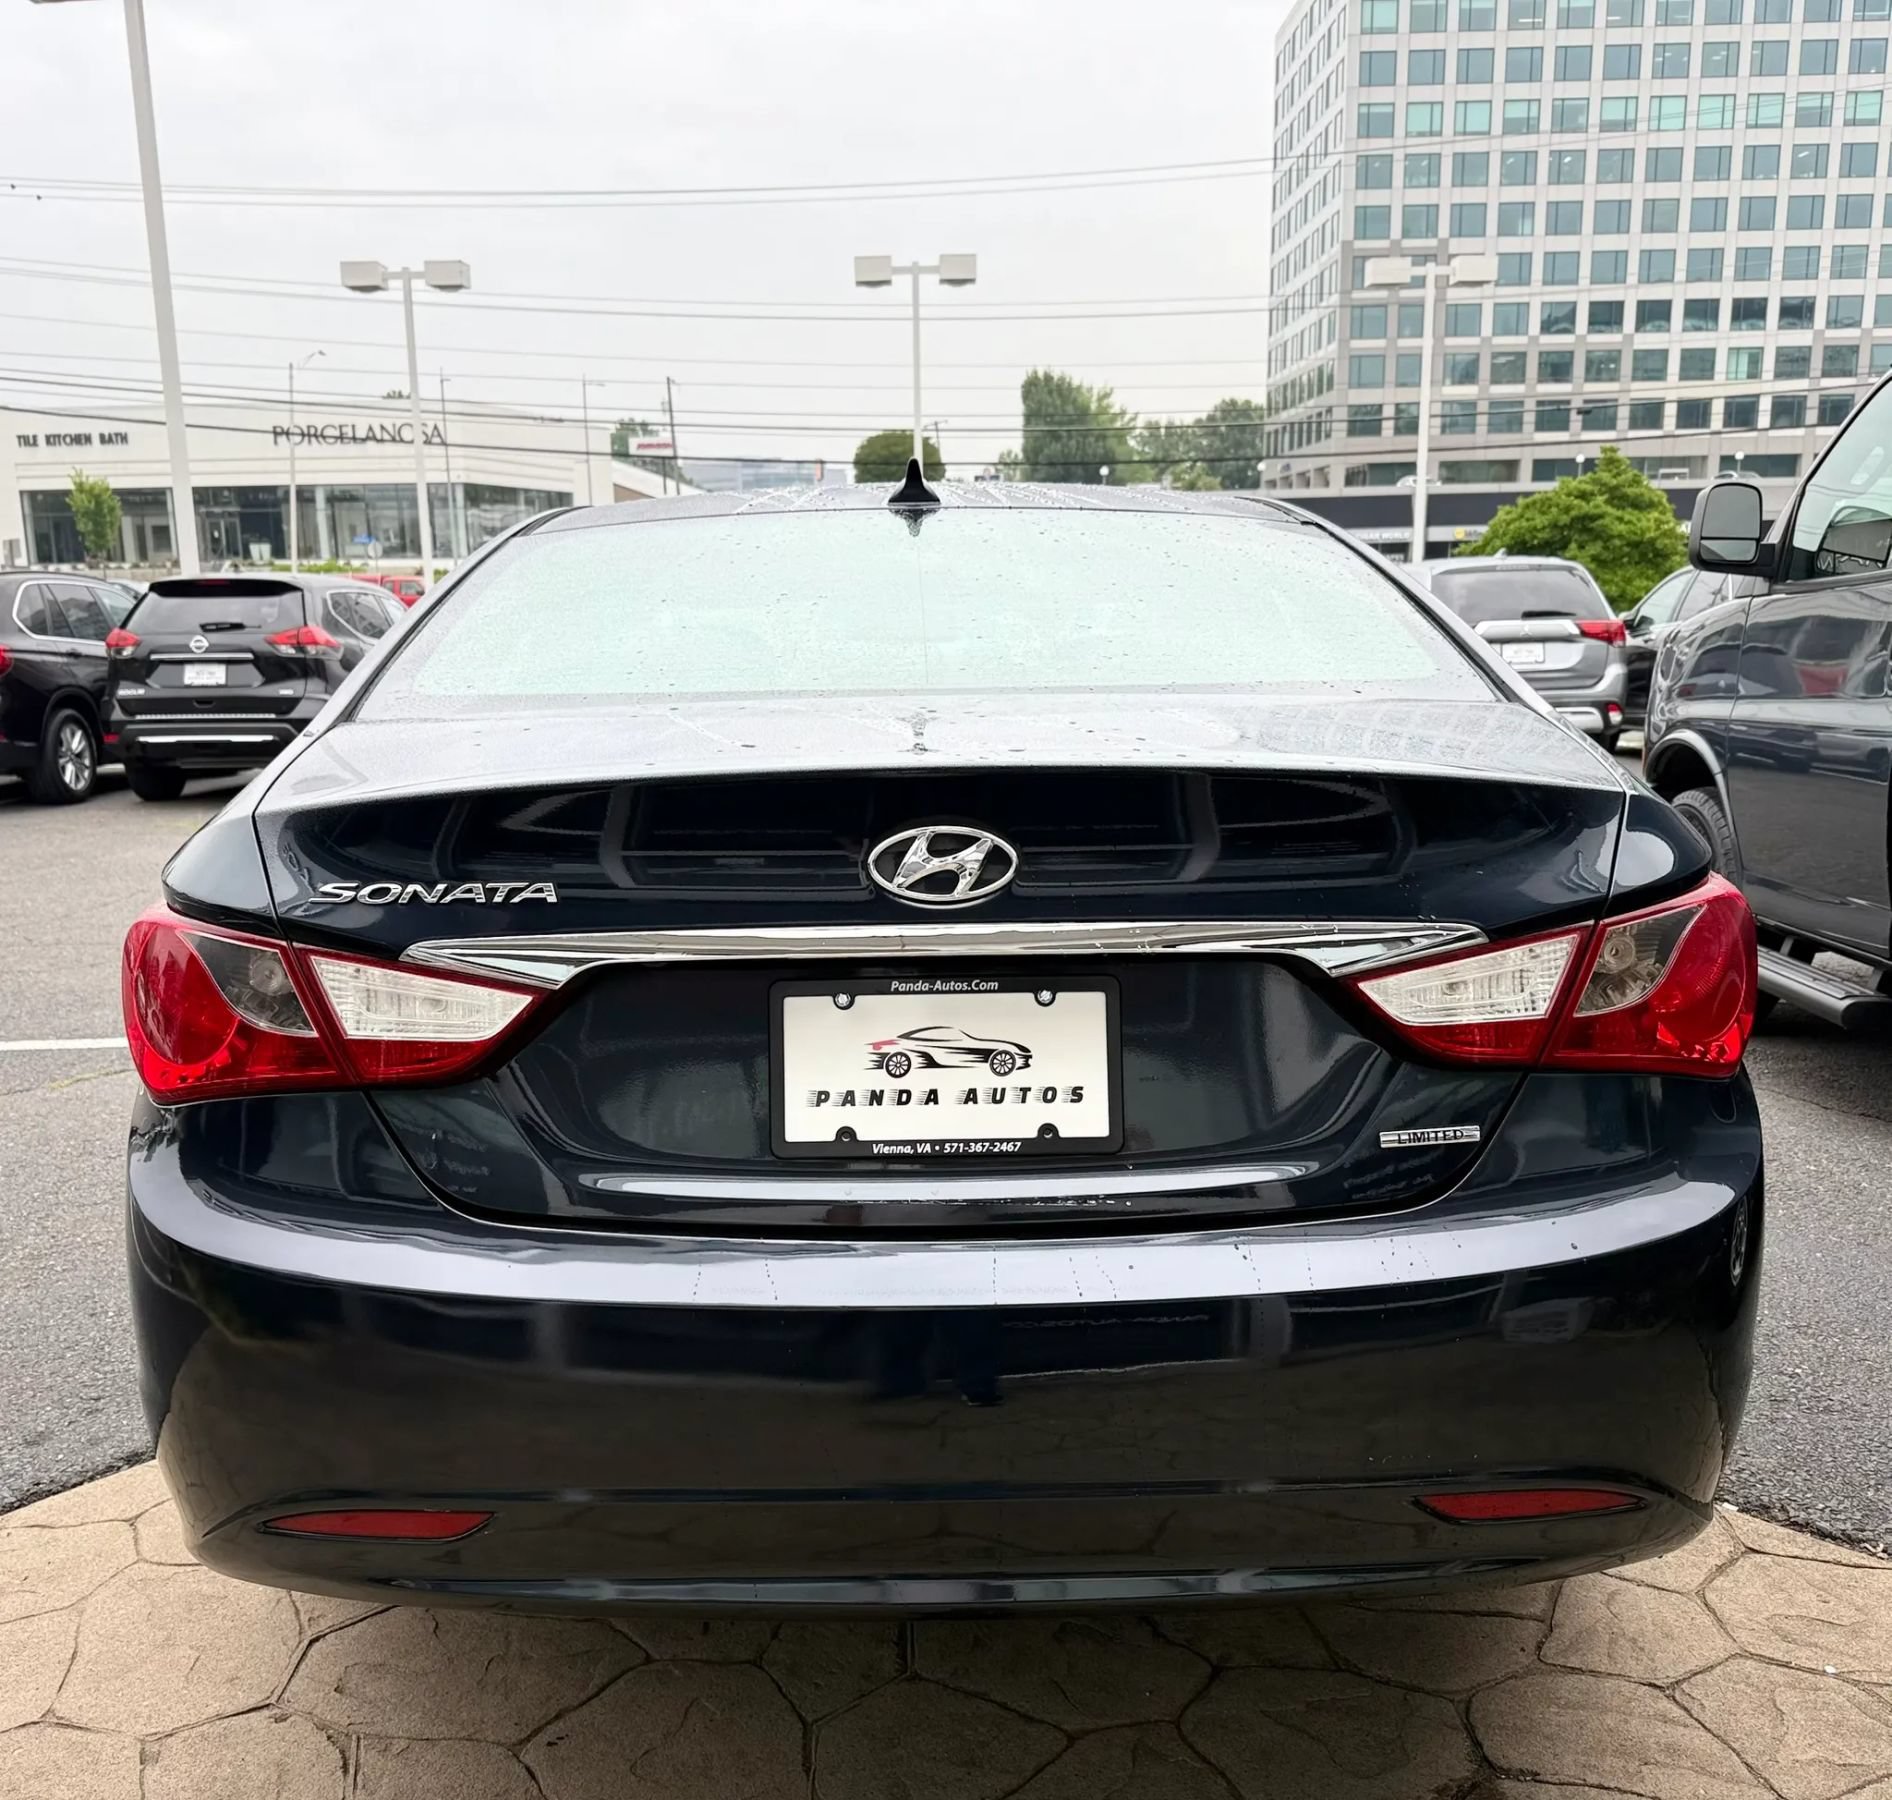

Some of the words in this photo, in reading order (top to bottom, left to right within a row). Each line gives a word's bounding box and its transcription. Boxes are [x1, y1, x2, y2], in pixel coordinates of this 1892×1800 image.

[16, 434, 39, 448] TILE
[45, 433, 93, 447] KITCHEN
[99, 432, 129, 446] BATH
[308, 882, 558, 904] SONATA
[890, 979, 999, 992] Panda-Autos.Com
[808, 1088, 940, 1107] PANDA
[955, 1086, 1084, 1105] AUTOS
[1397, 1129, 1464, 1145] LIMITED
[872, 1142, 914, 1155] Vienna,
[915, 1142, 932, 1154] VA
[943, 1141, 1022, 1154] 571-367-2467
